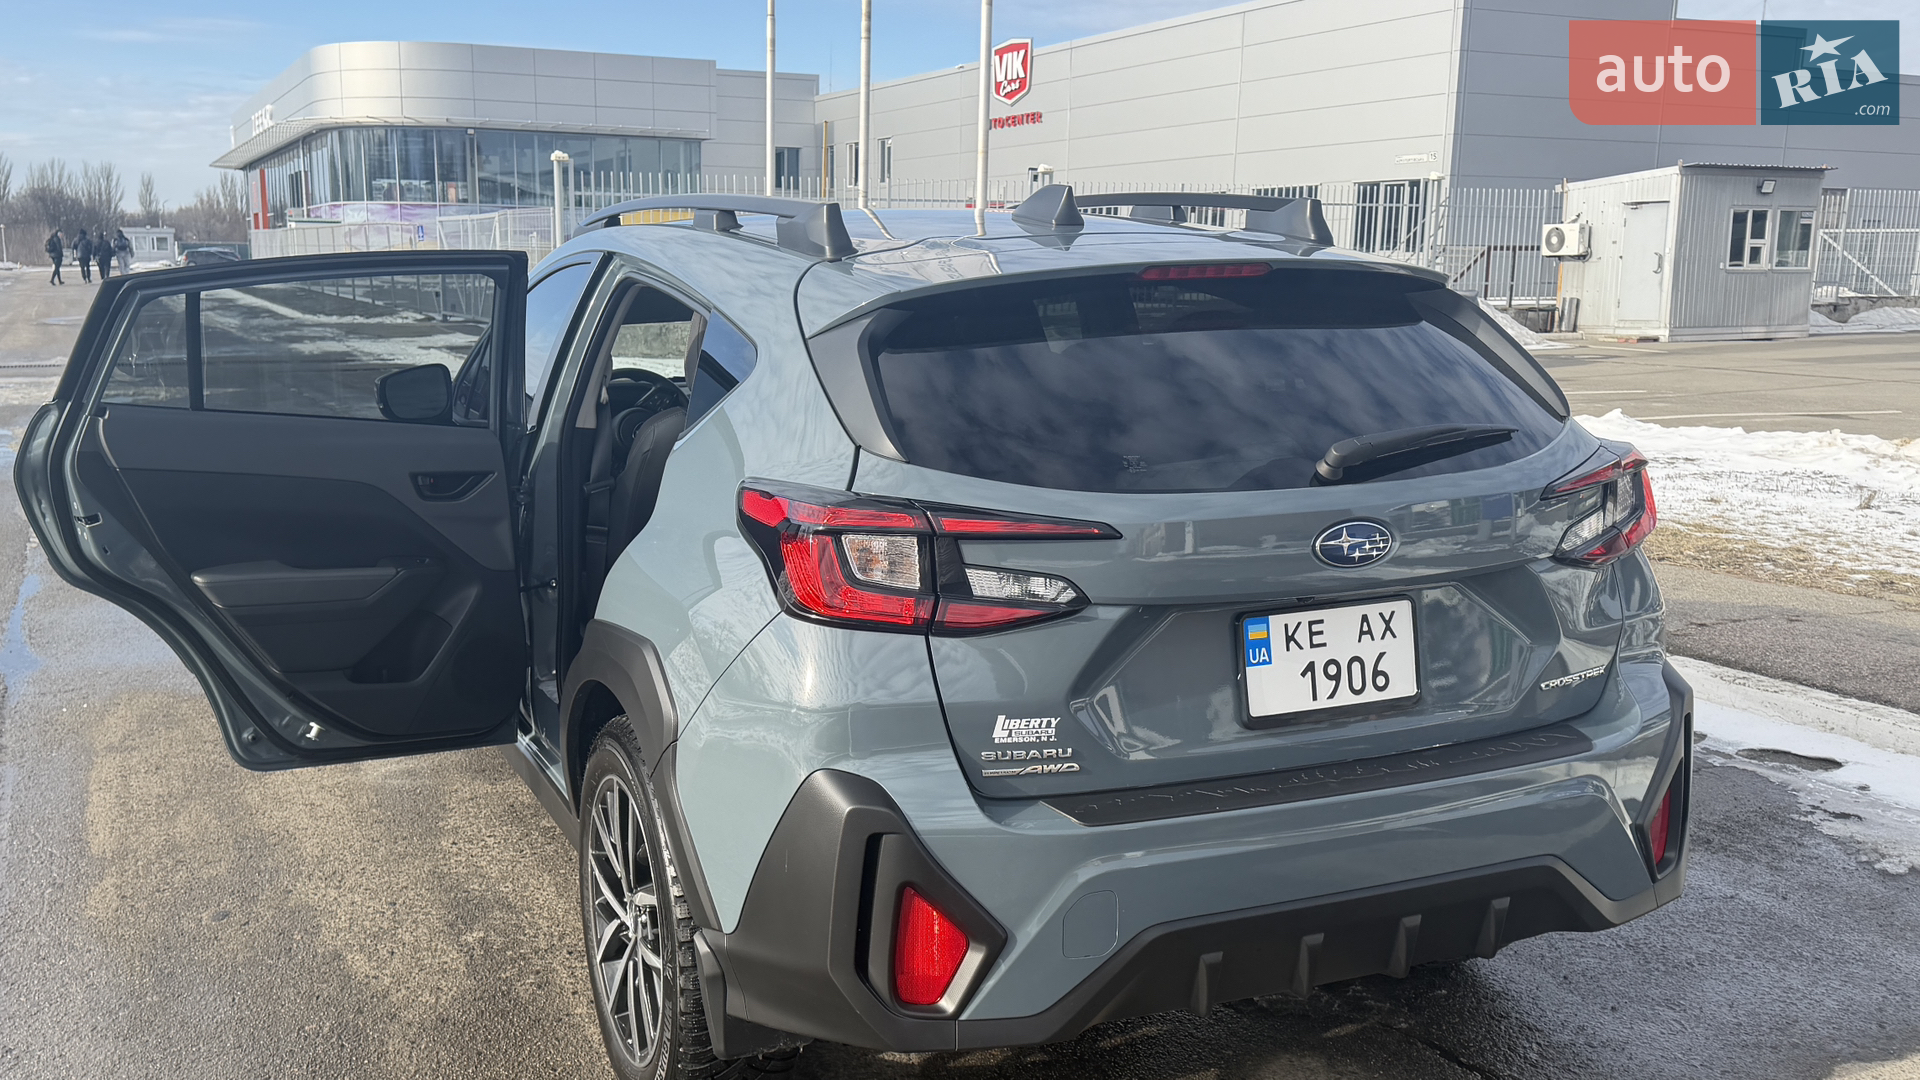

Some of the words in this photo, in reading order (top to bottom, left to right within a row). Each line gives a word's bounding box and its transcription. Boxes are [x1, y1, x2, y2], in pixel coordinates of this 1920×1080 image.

[994, 49, 1026, 82] VIK
[1000, 80, 1020, 96] Cars
[989, 111, 1043, 130] TOCENTER
[1284, 619, 1327, 652] KE
[1358, 610, 1397, 643] AX
[1249, 647, 1270, 664] UA
[1300, 651, 1390, 702] 1906
[1540, 665, 1606, 690] CROSSTREK
[992, 715, 1061, 738] LIBERTY
[981, 748, 1072, 761] SUBARU
[1019, 763, 1080, 775] AWD
